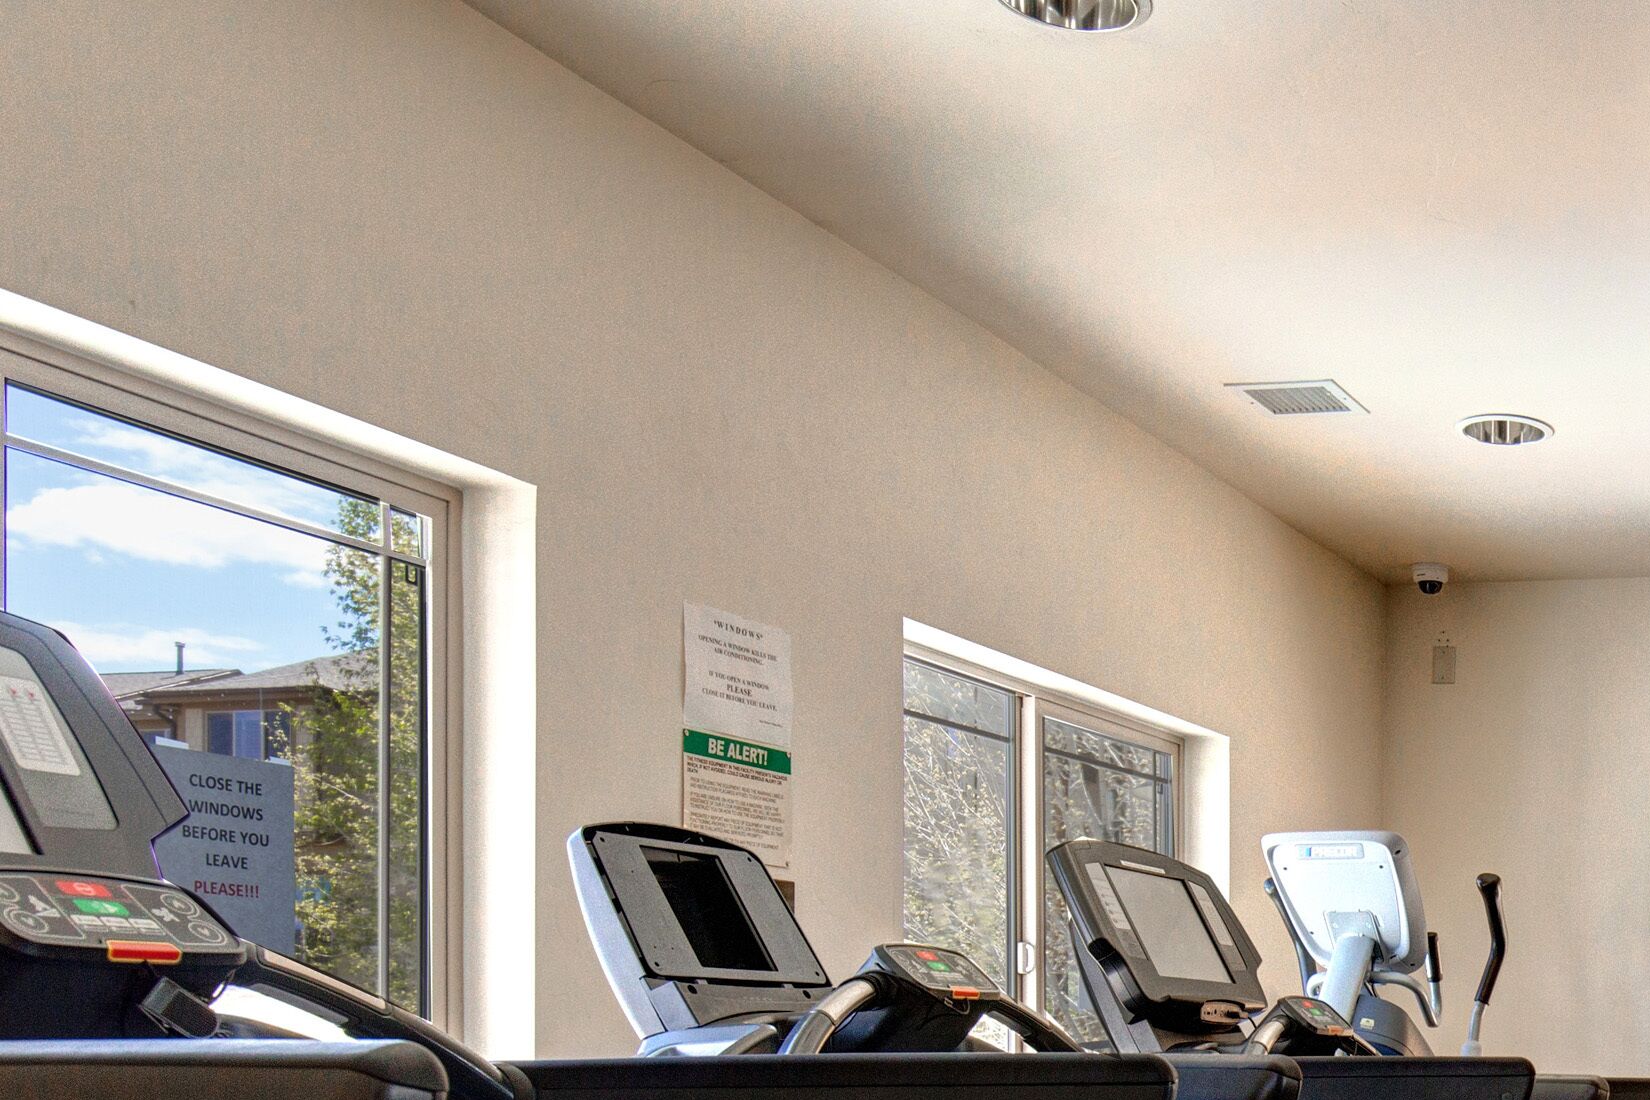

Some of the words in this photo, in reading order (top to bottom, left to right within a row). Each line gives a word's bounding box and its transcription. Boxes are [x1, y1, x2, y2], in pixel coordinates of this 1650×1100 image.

[728, 643, 750, 653] WINDOW
[727, 684, 752, 698] PLEASE
[708, 738, 724, 756] BE
[727, 743, 768, 765] ALERT!
[189, 774, 232, 791] CLOSE
[237, 780, 262, 796] THE
[189, 800, 263, 821] WINDOWS
[183, 825, 236, 843] BEFORE
[240, 831, 269, 847] YOU
[206, 853, 248, 870] LEAVE
[194, 880, 259, 898] PLEASE!!!
